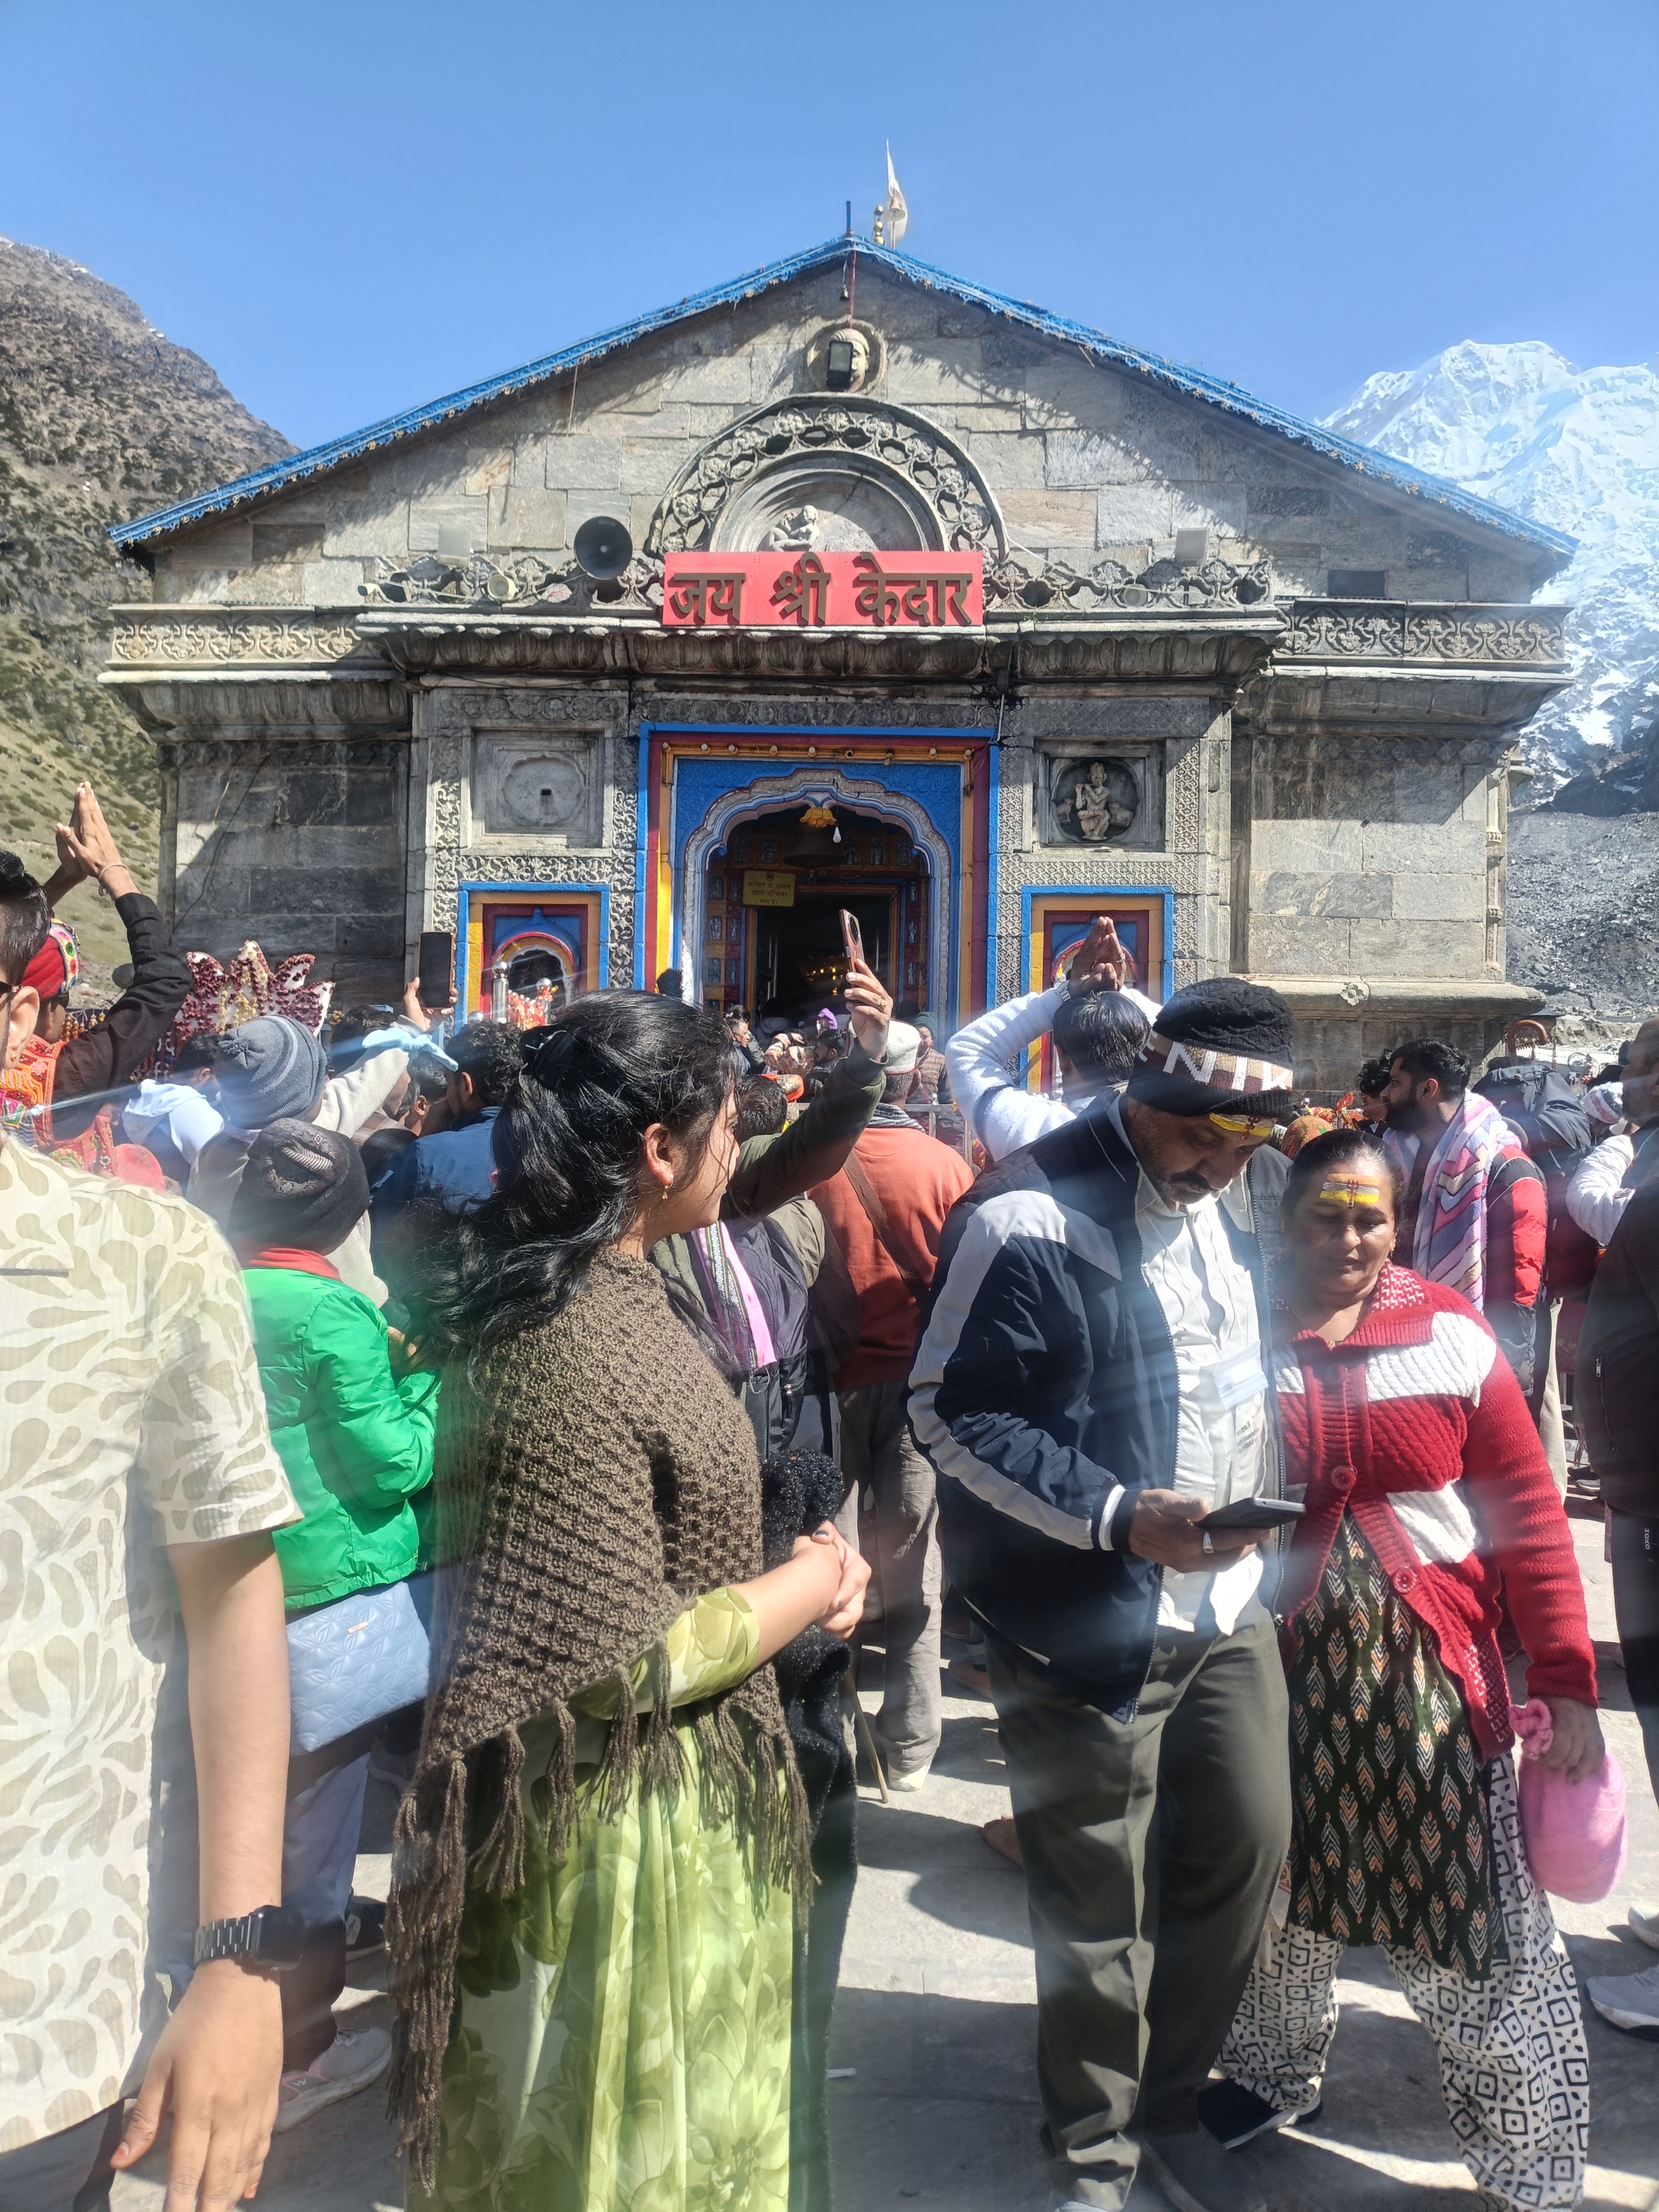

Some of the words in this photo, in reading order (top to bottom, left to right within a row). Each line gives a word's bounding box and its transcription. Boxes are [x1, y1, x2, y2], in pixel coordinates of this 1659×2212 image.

[668, 572, 746, 625] जय
[770, 552, 831, 626] श्री
[853, 552, 973, 626] केदार
